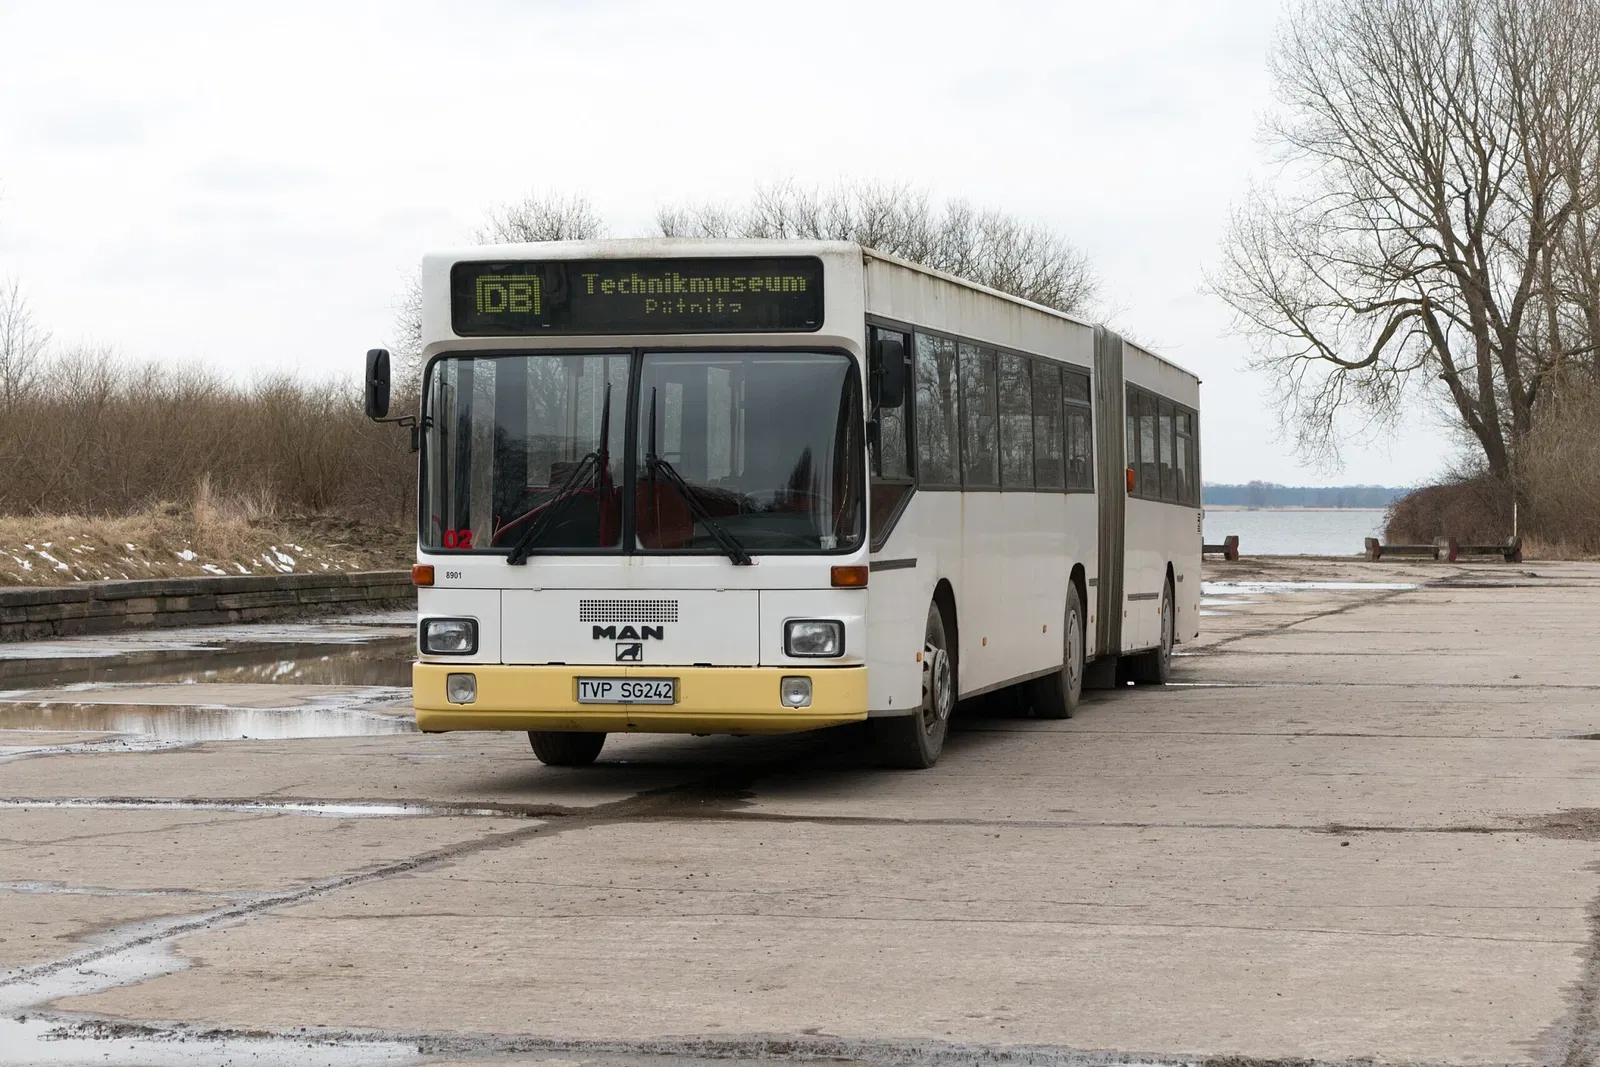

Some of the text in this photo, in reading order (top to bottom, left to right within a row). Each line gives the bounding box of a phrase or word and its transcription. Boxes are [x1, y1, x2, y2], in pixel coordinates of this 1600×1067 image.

[581, 272, 807, 295] Technikmuseum
[484, 283, 532, 313] DB
[443, 529, 473, 550] 02
[445, 571, 462, 580] 8901
[592, 625, 664, 640] MAN
[580, 681, 673, 699] TVP SG242
